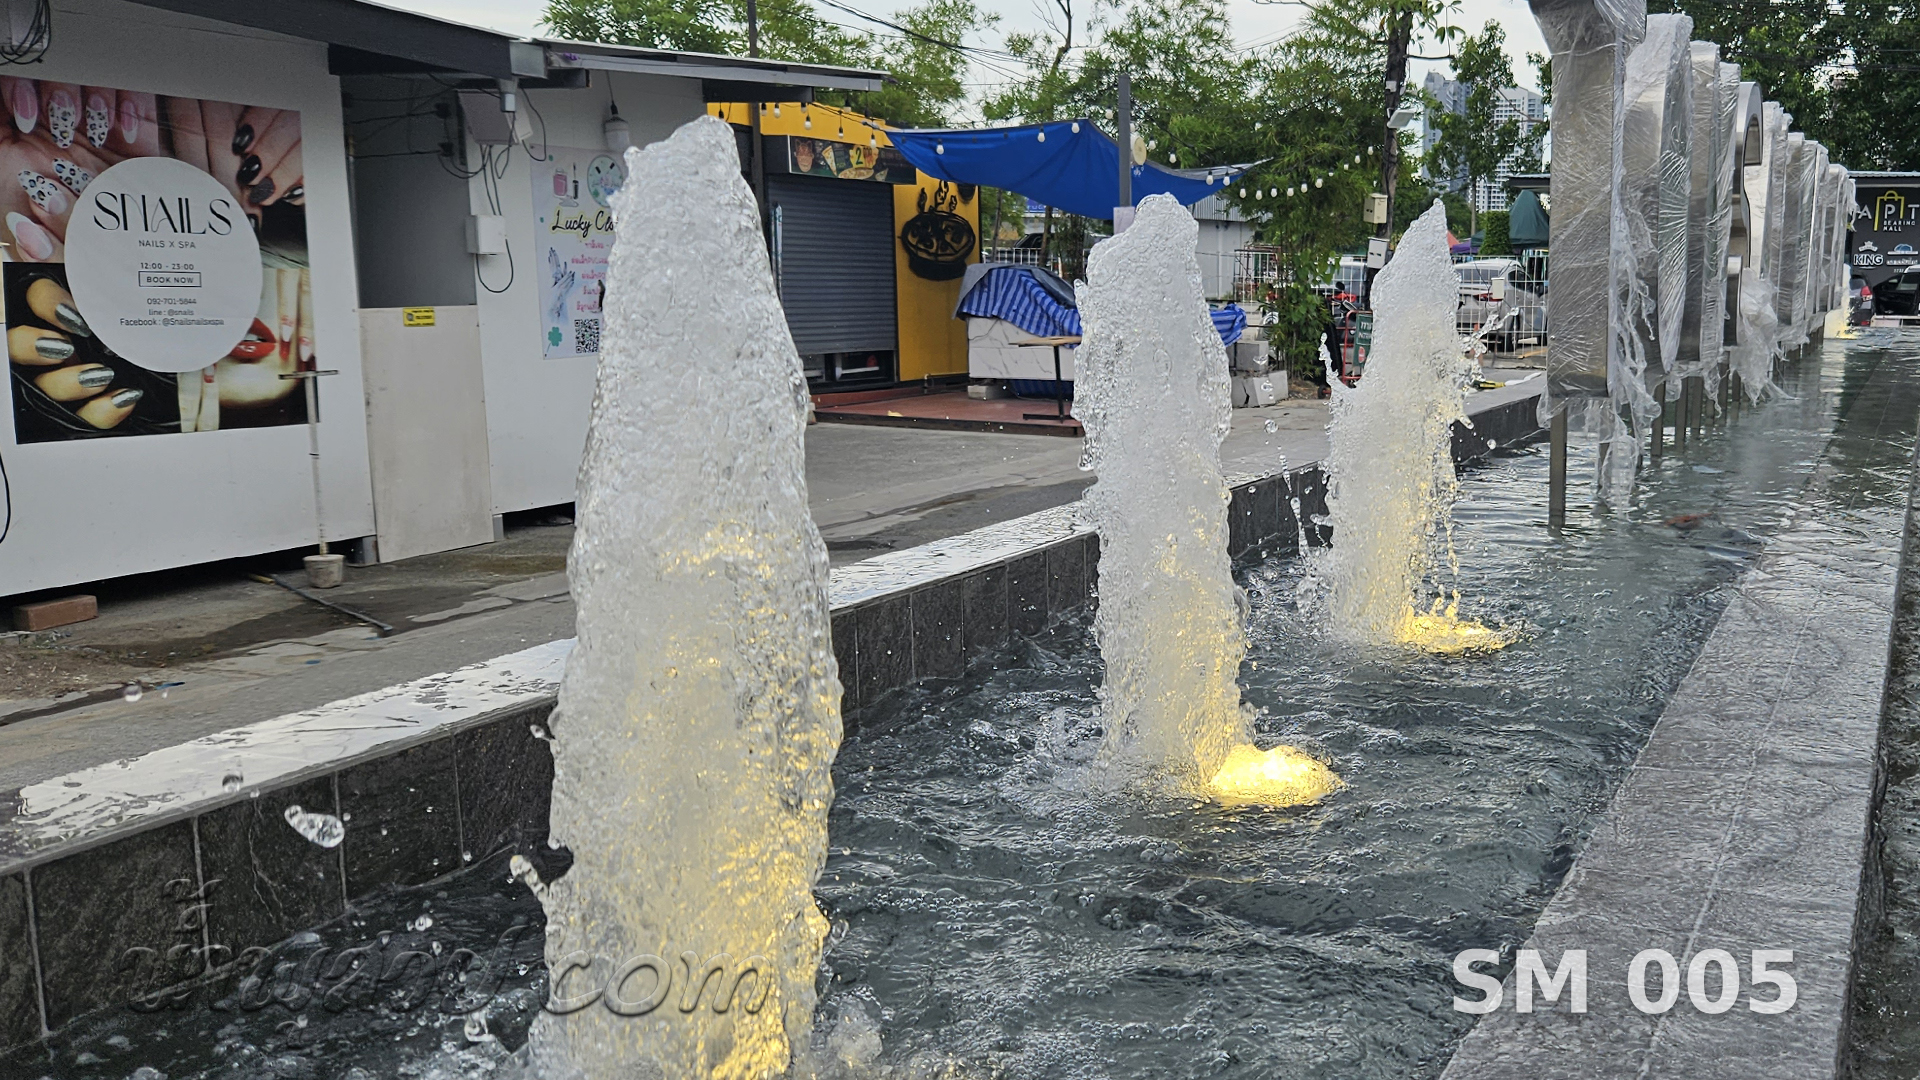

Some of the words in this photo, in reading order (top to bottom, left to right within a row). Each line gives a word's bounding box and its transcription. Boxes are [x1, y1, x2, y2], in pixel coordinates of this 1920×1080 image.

[93, 191, 232, 236] SNAILS
[551, 210, 593, 238] Lucky
[138, 239, 165, 248] NAILS
[178, 240, 196, 249] SPA
[140, 262, 163, 270] 12:00
[1853, 253, 1884, 266] KING
